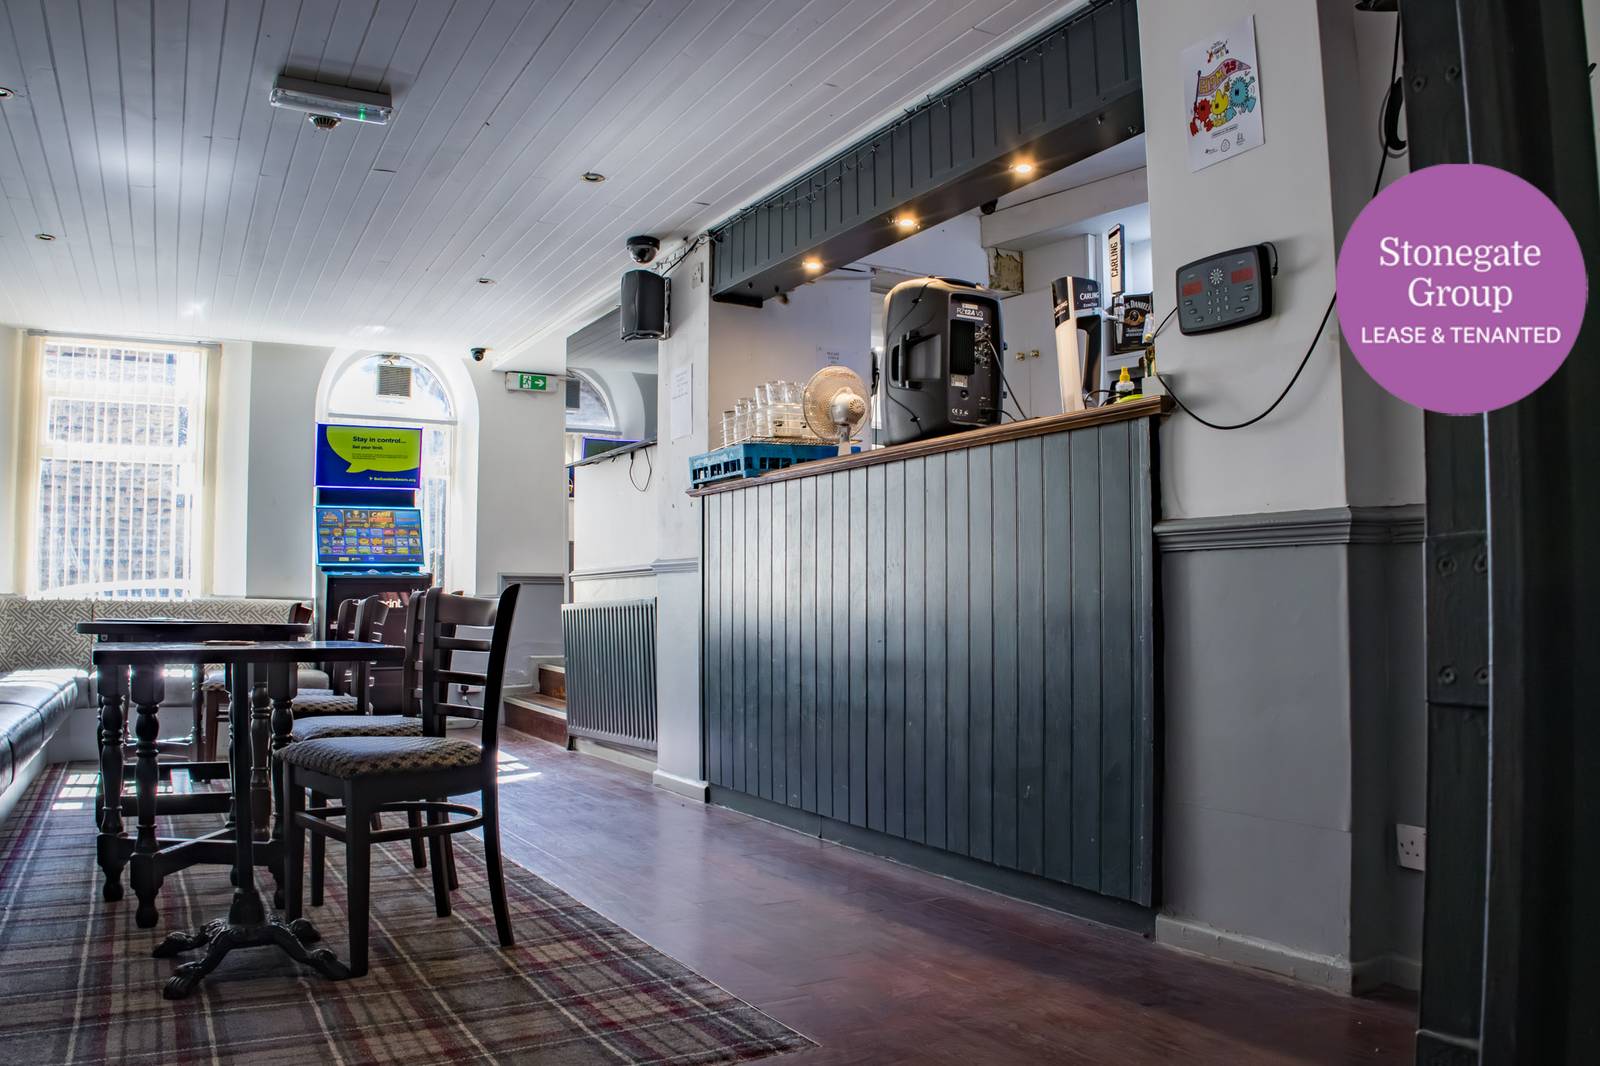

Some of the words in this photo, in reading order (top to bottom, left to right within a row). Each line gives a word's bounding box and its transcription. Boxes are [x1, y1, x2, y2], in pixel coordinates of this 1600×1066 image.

[1110, 241, 1119, 278] CARLING
[1079, 292, 1100, 300] CARLING
[352, 435, 368, 444] Stay
